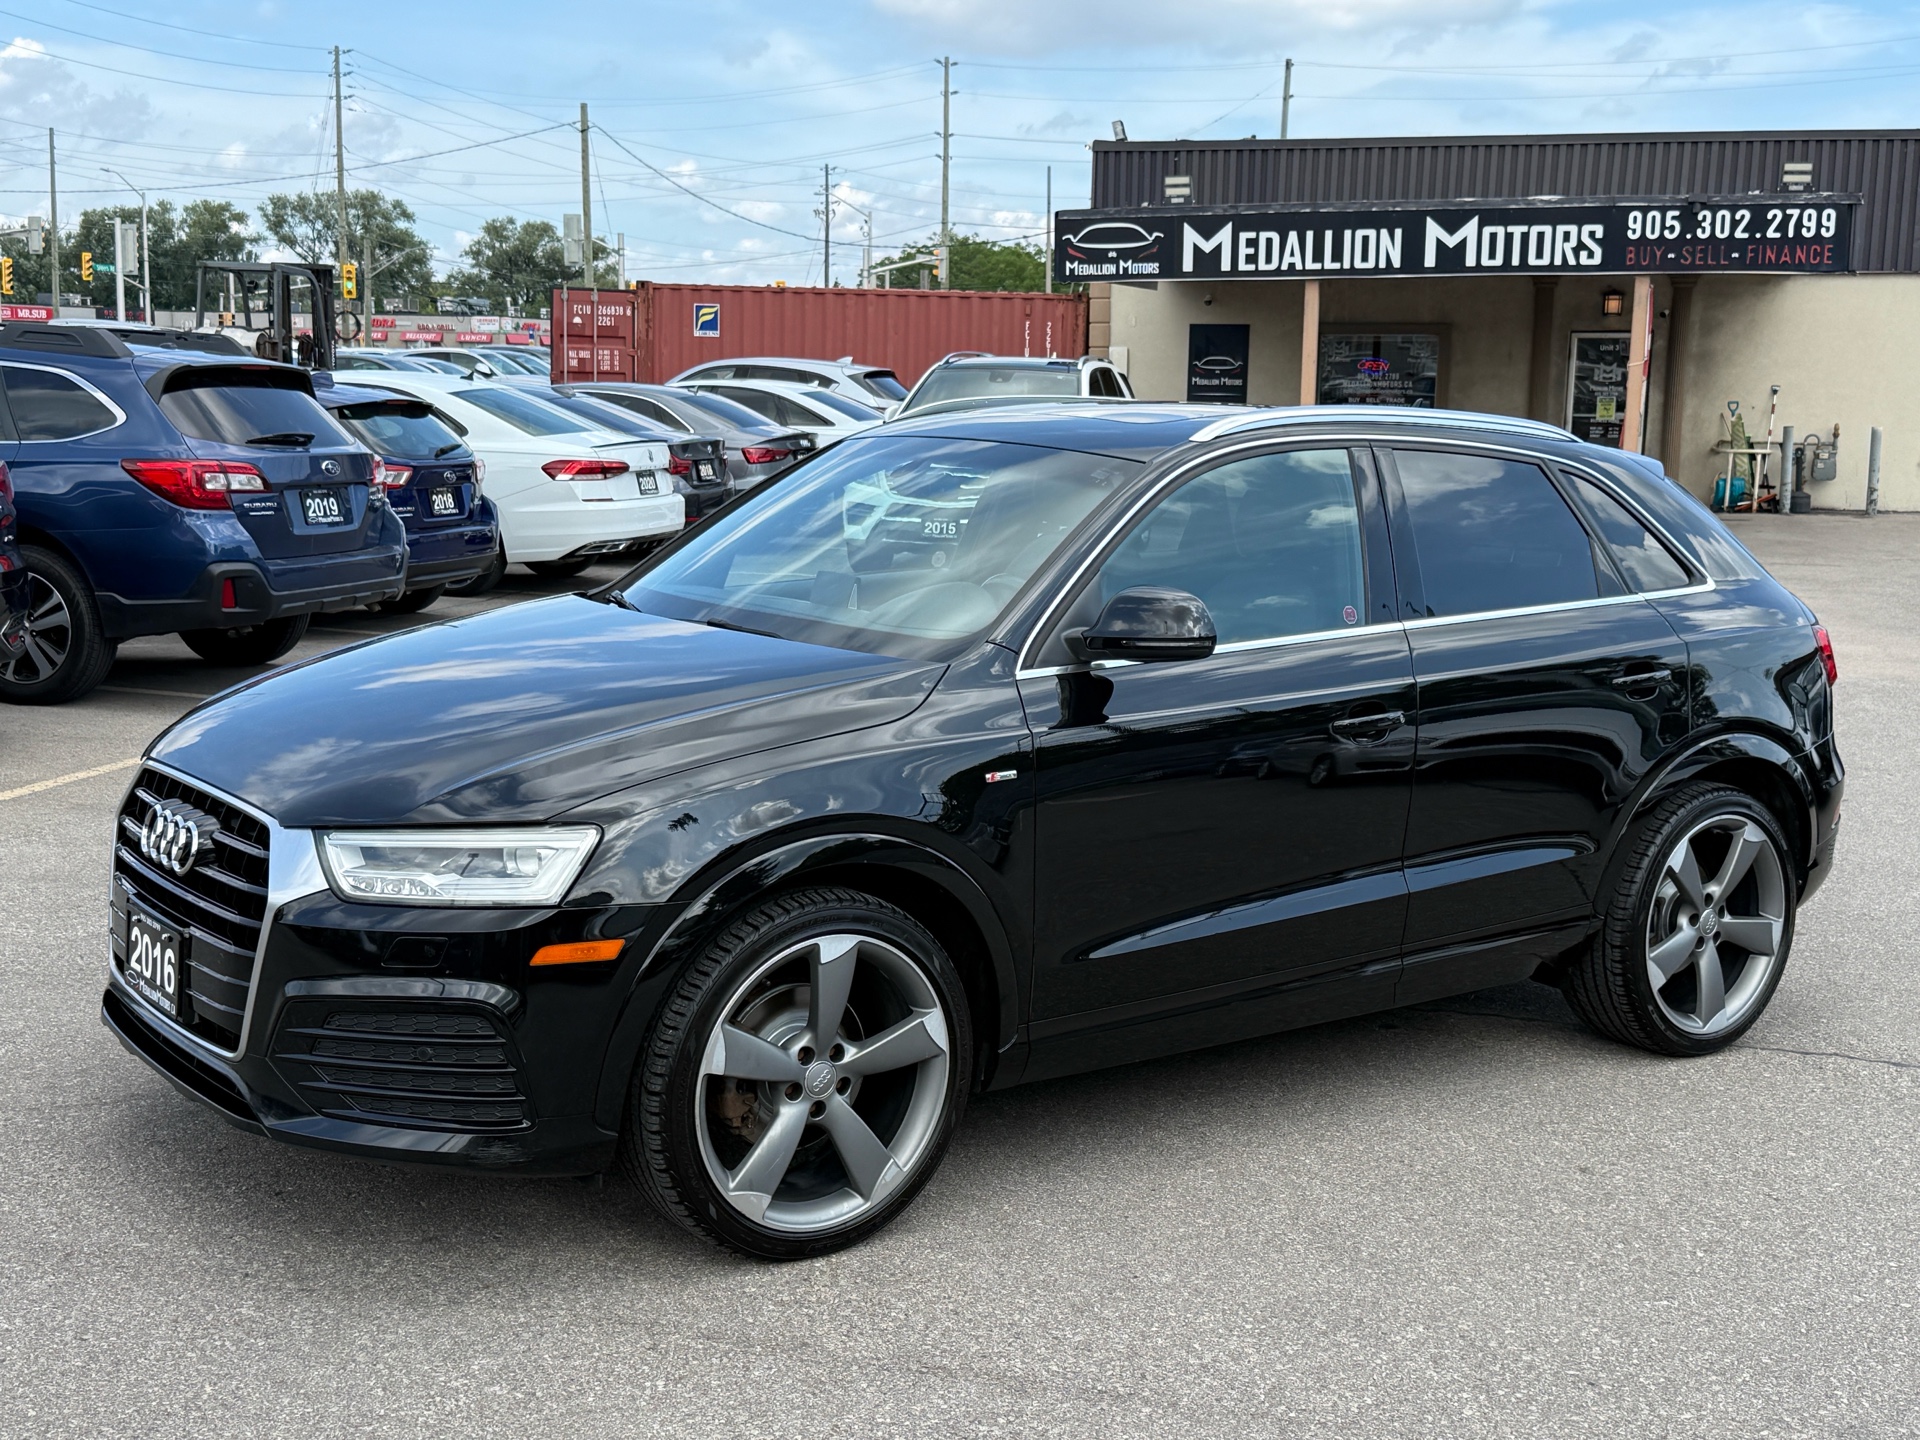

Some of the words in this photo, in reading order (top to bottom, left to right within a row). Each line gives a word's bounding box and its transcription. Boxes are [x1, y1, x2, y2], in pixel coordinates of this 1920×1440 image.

[1627, 208, 1836, 240] 905.302.2799
[1182, 221, 1403, 272] MEDALLION
[1424, 215, 1604, 268] MOTORS
[1625, 246, 1665, 265] BUY
[1680, 245, 1729, 265] SELL
[1746, 244, 1834, 264] FINANCE
[1065, 260, 1116, 276] MEDALLION
[1119, 259, 1159, 275] MOTORS
[573, 304, 592, 315] FCIU
[598, 305, 624, 316] 266838
[598, 316, 615, 326] 22G1
[460, 333, 487, 341] LUNCH
[1357, 360, 1390, 370] OPEN
[1191, 377, 1220, 386] MEDALLION
[1220, 377, 1243, 386] MOTORS
[306, 497, 339, 517] 2019
[432, 493, 455, 510] 2018
[924, 522, 957, 535] 2015
[130, 926, 176, 995] 2016
